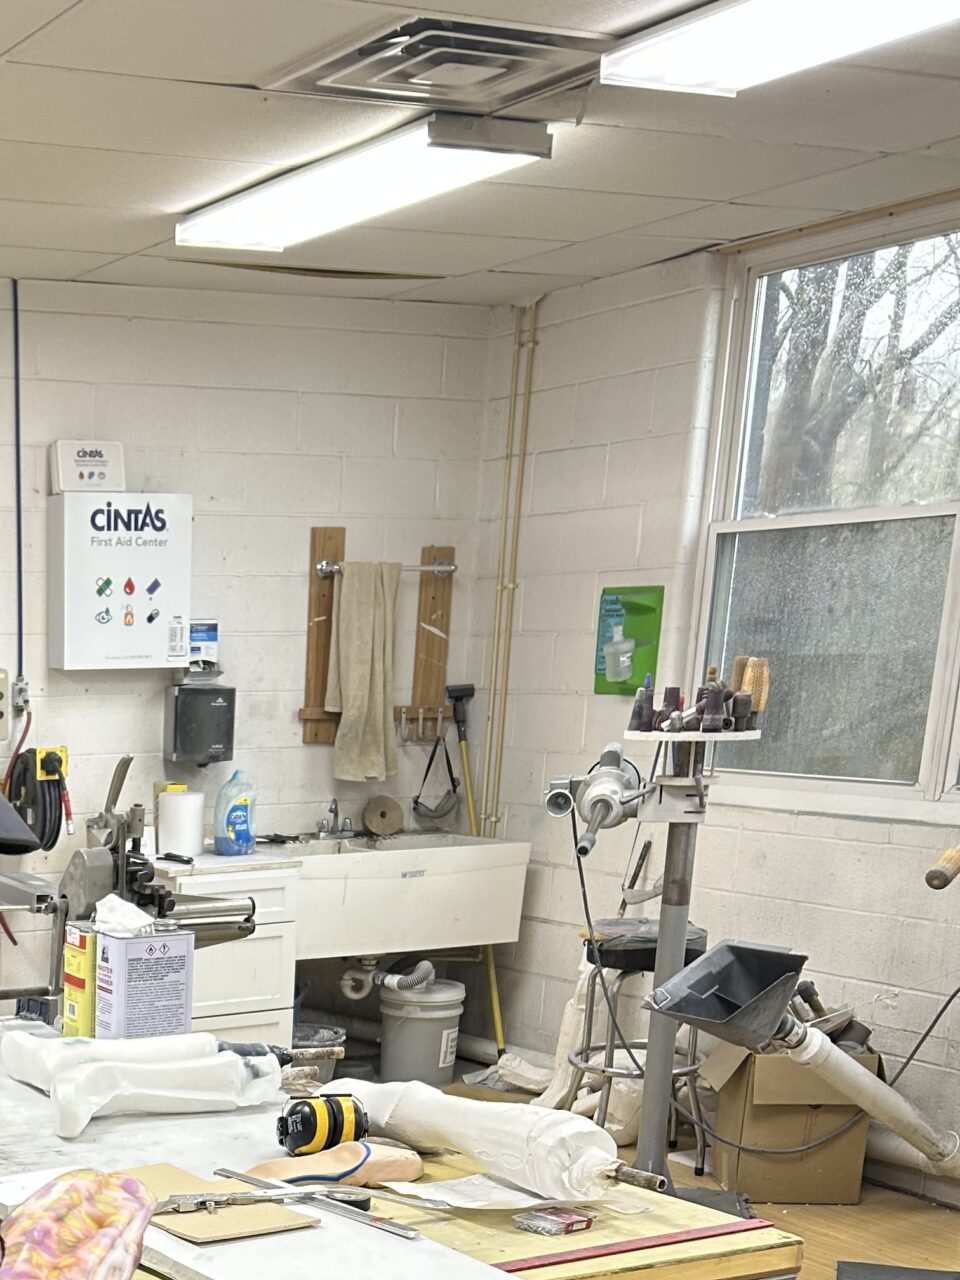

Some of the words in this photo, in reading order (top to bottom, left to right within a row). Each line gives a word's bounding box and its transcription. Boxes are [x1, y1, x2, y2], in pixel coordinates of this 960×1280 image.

[90, 536, 113, 547] First
[115, 536, 132, 547] Aid
[135, 536, 168, 547] Center
